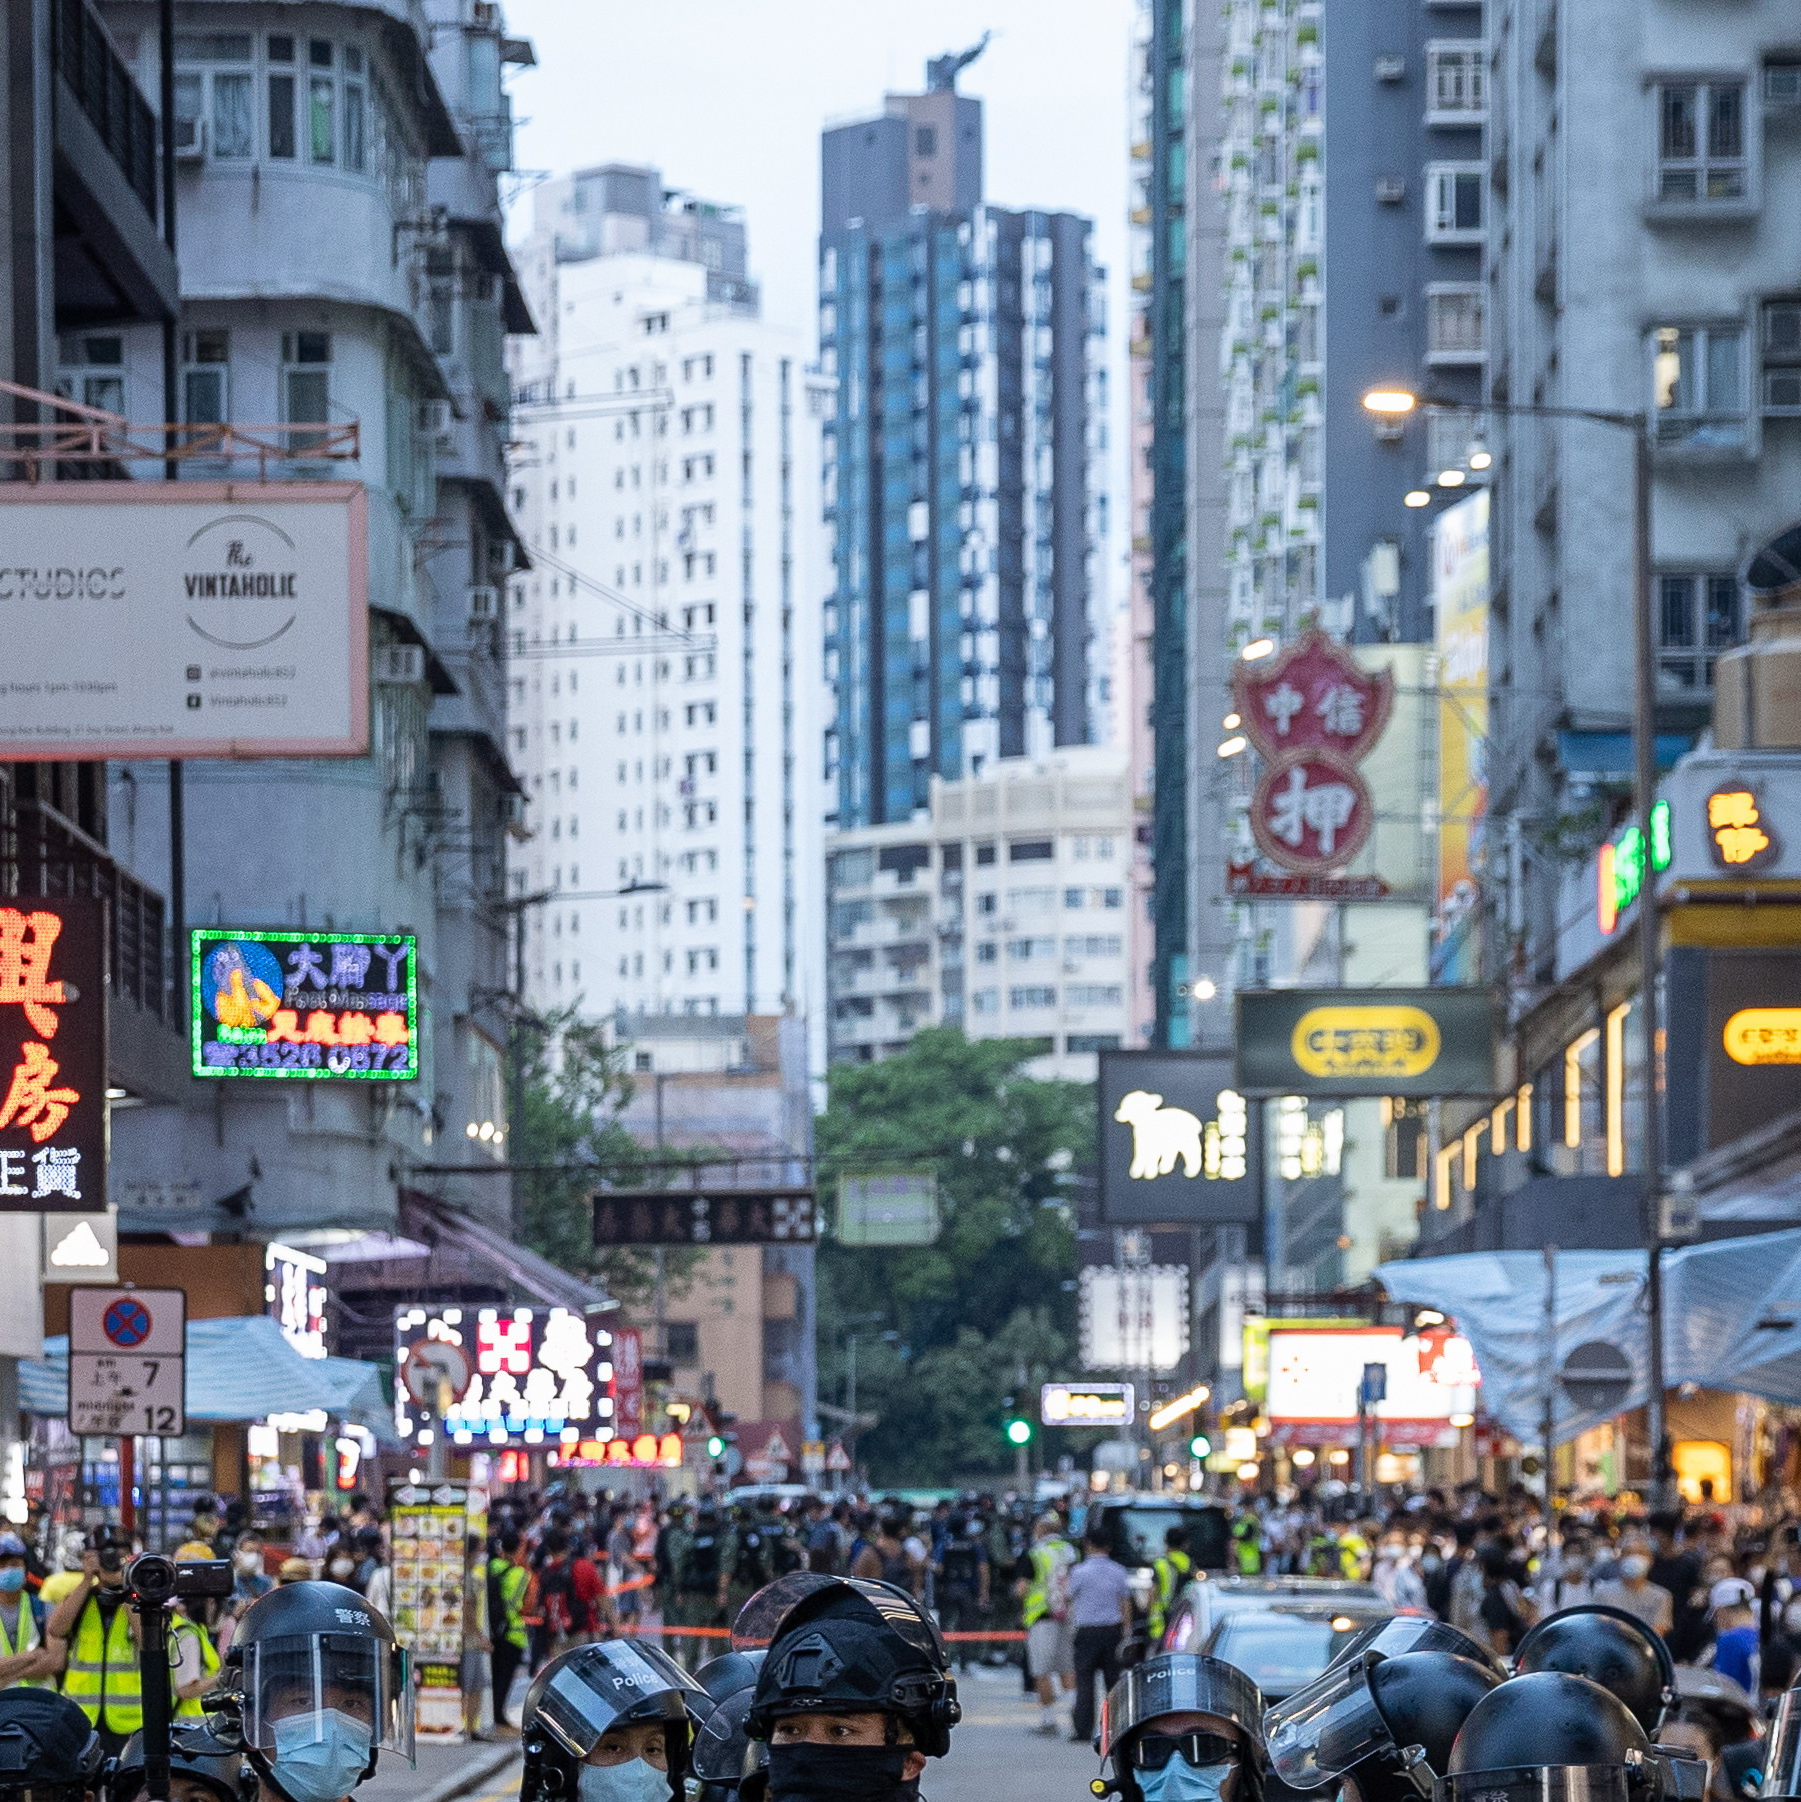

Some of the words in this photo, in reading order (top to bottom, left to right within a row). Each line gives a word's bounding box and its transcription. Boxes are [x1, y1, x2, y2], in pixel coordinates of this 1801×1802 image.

[184, 572, 296, 599] VINTAHOLIC
[1269, 766, 1357, 856] 押
[142, 1361, 161, 1387] 7
[144, 1405, 175, 1431] 12
[611, 1670, 659, 1690] Police
[1147, 1666, 1197, 1683] Police
